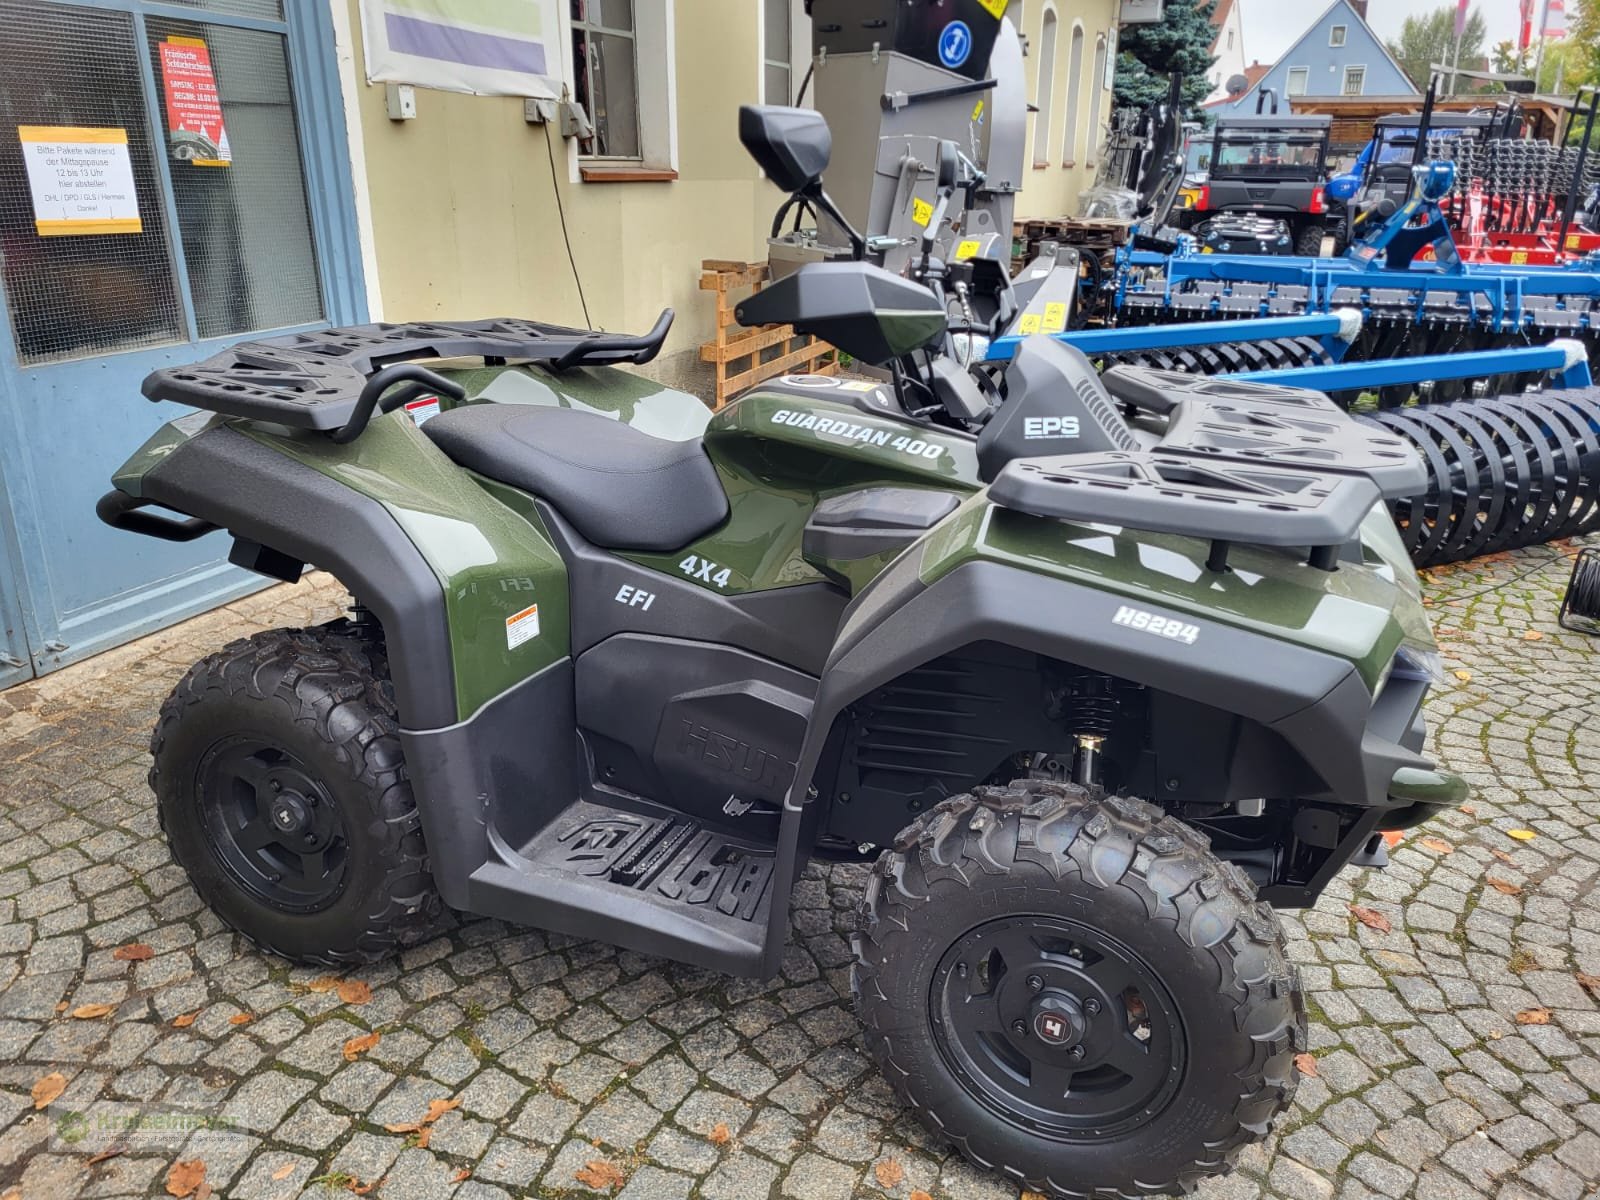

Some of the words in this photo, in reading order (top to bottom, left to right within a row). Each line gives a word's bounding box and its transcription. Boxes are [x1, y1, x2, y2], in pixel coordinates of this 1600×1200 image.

[36, 145, 55, 154] Bitte
[57, 146, 82, 155] Pakete
[84, 146, 116, 155] während
[45, 158, 58, 166] der
[60, 158, 109, 168] Mittagspause
[56, 169, 65, 177] 12
[67, 169, 78, 177] bis
[80, 169, 89, 177] 13
[90, 169, 104, 177] Uhr
[58, 180, 73, 188] hier
[75, 180, 107, 189] abstellen
[44, 194, 59, 202] DHL
[1024, 416, 1080, 435] EPS
[770, 408, 891, 447] GUARDIAN
[891, 435, 945, 459] 400
[679, 554, 732, 588] 4X4
[614, 584, 656, 611] EFI
[1112, 605, 1200, 645] HS284
